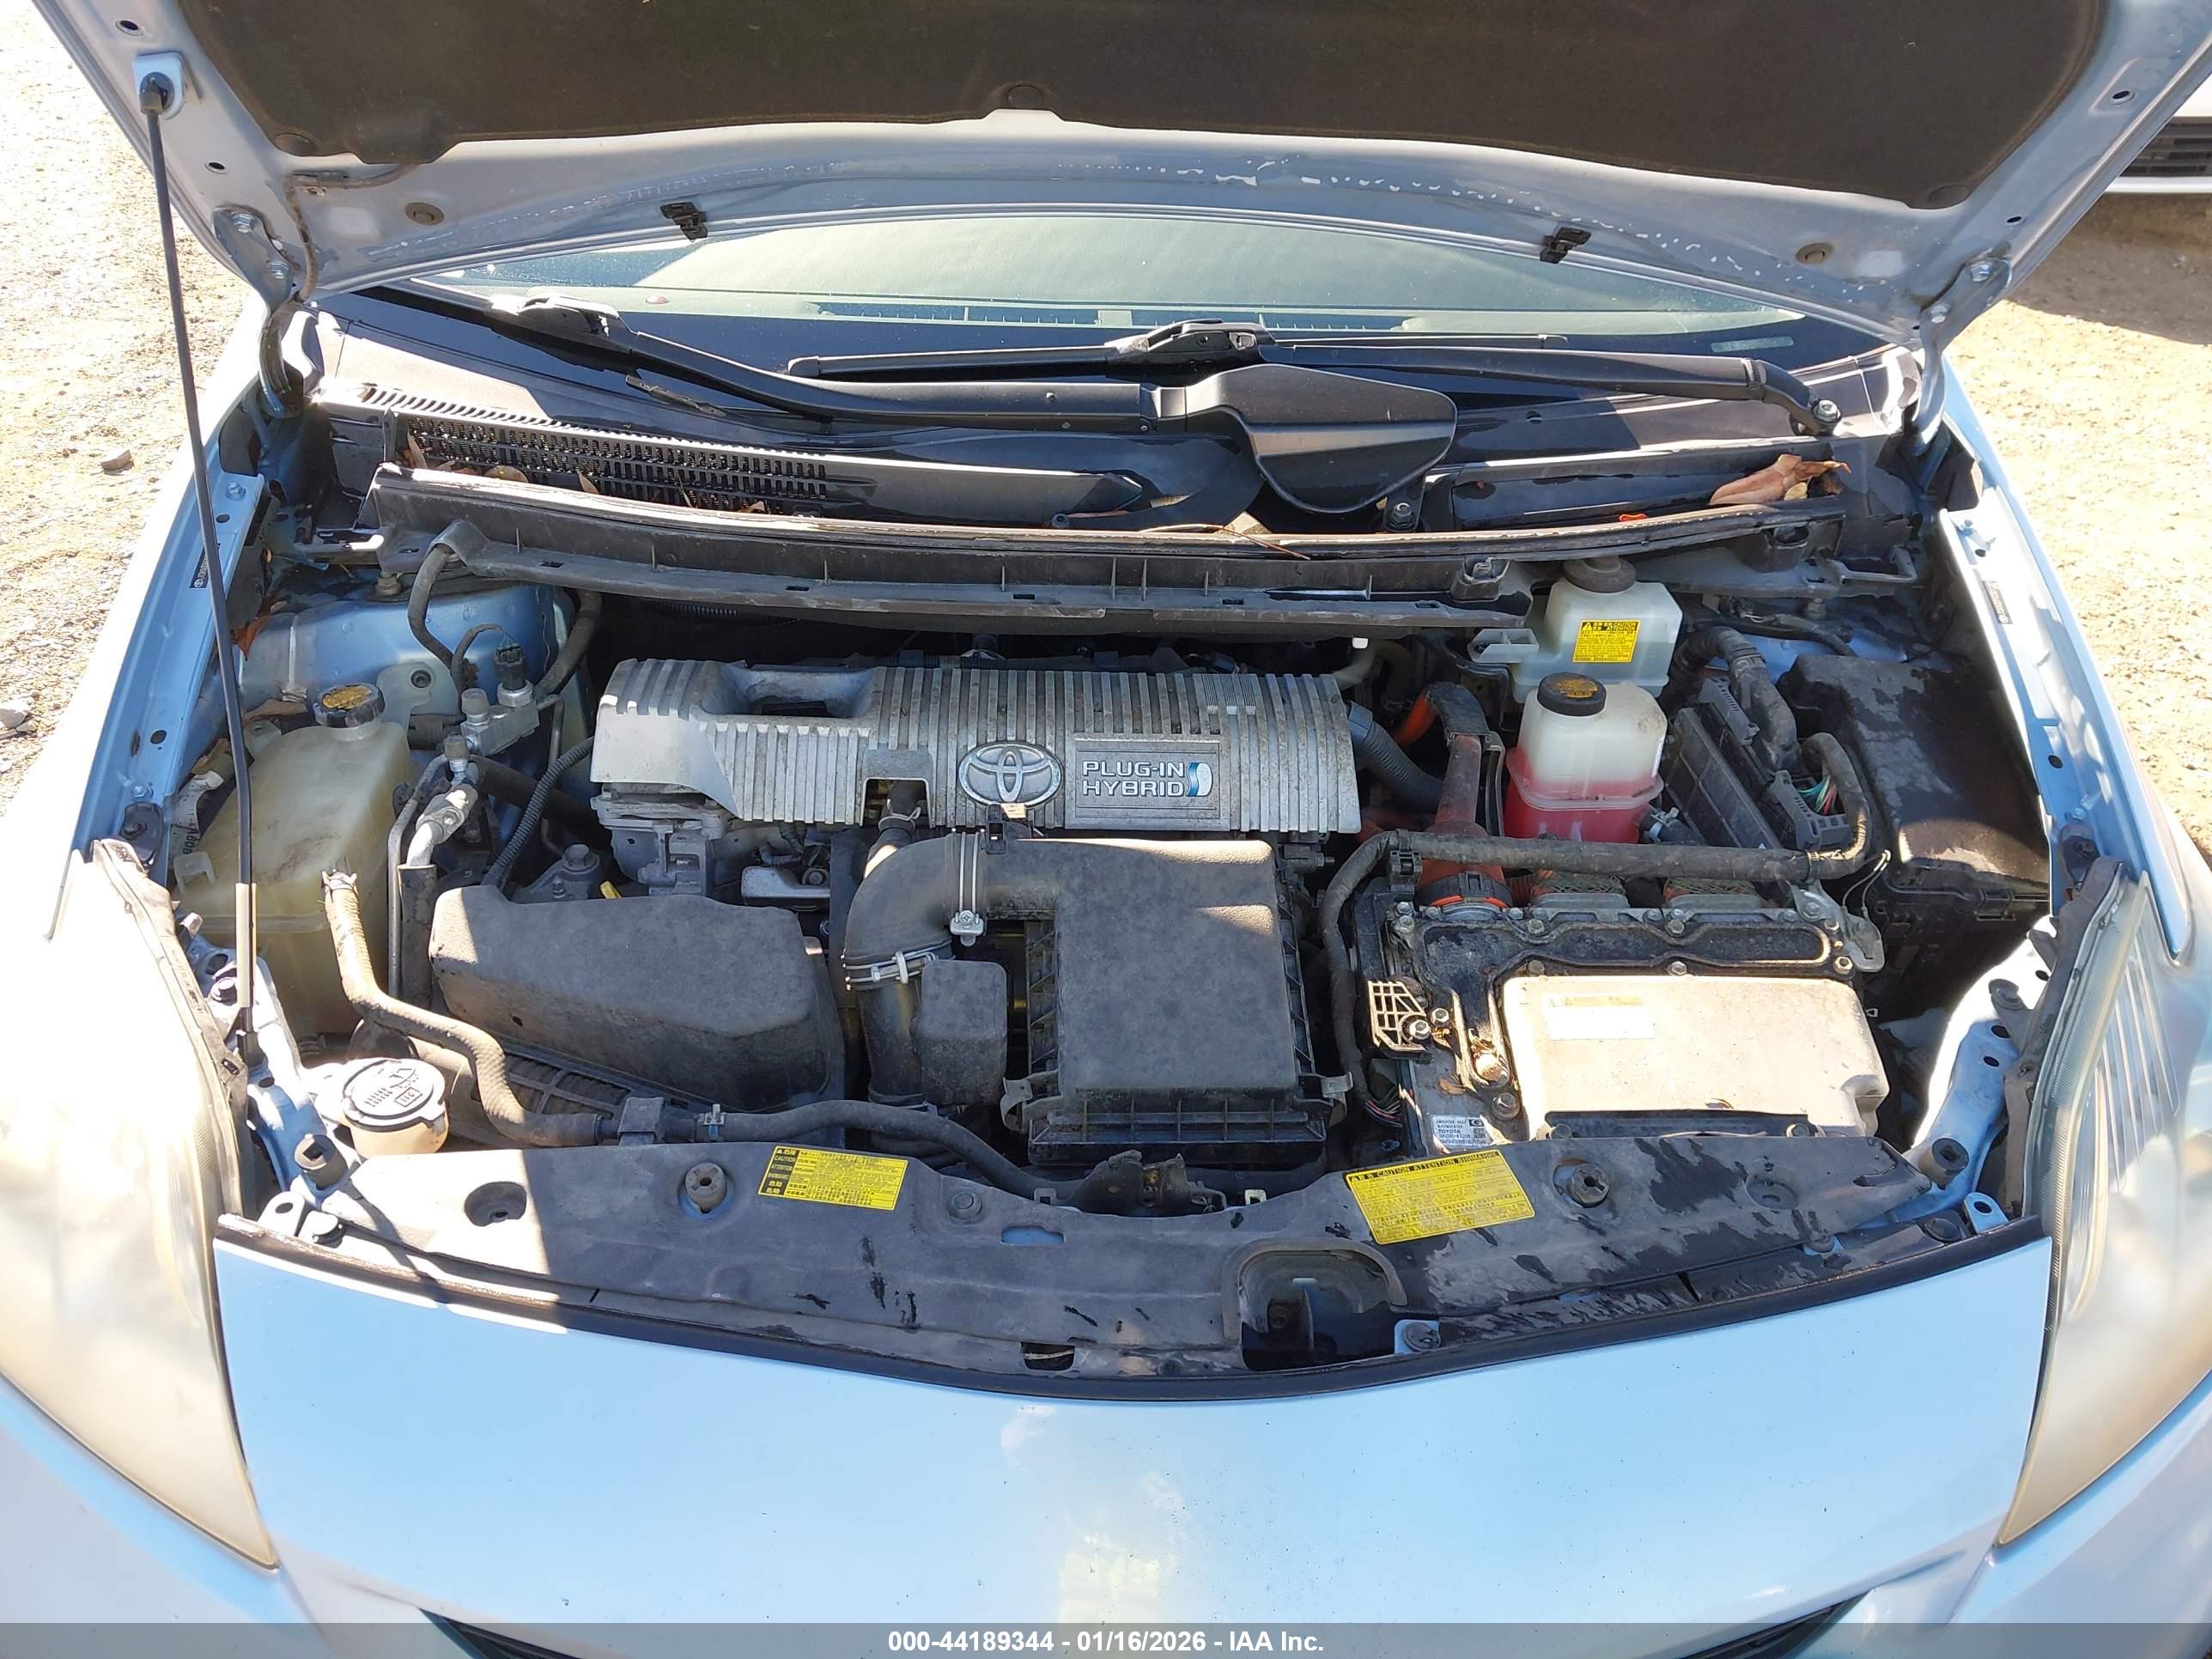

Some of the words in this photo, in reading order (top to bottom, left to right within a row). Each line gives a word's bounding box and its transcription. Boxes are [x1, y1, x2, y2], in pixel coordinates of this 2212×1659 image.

[1082, 761, 1185, 778] PLUG-IN
[1082, 780, 1185, 797] HYBRID
[1376, 1166, 1411, 1177] CAUTION
[1413, 1158, 1455, 1171] ATTENTION
